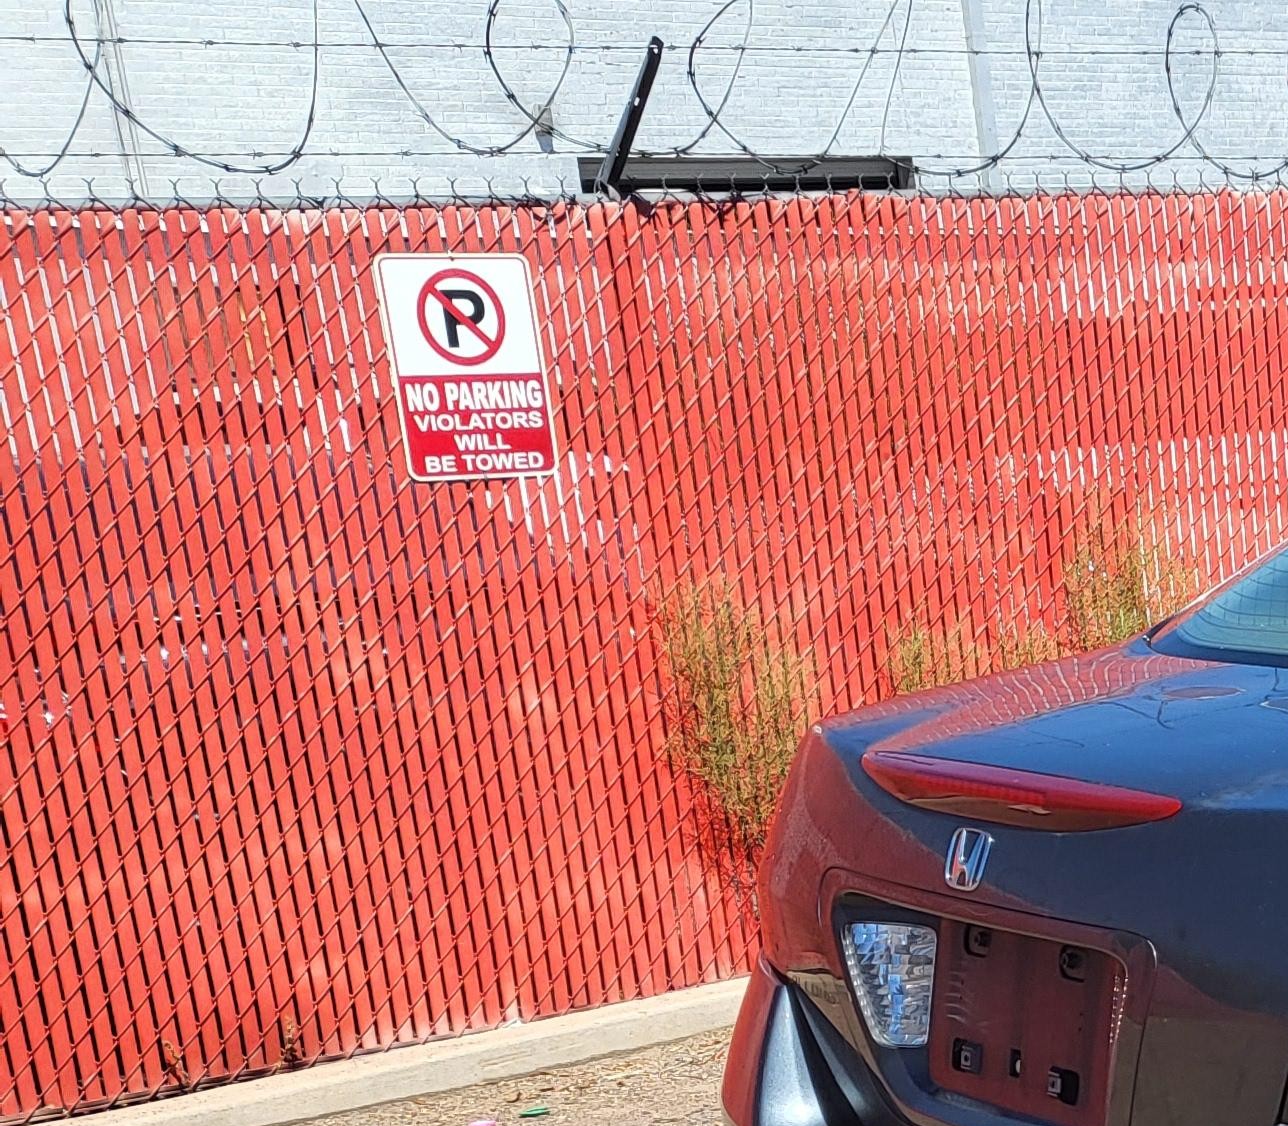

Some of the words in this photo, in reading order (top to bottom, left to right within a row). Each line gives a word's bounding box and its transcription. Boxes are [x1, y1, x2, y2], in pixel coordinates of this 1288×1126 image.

[405, 382, 440, 412] NO
[444, 380, 544, 411] PARKING
[413, 411, 544, 432] VIOLATORS
[454, 433, 512, 451] WILL
[424, 455, 457, 473] BE
[461, 452, 544, 472] TOWED
